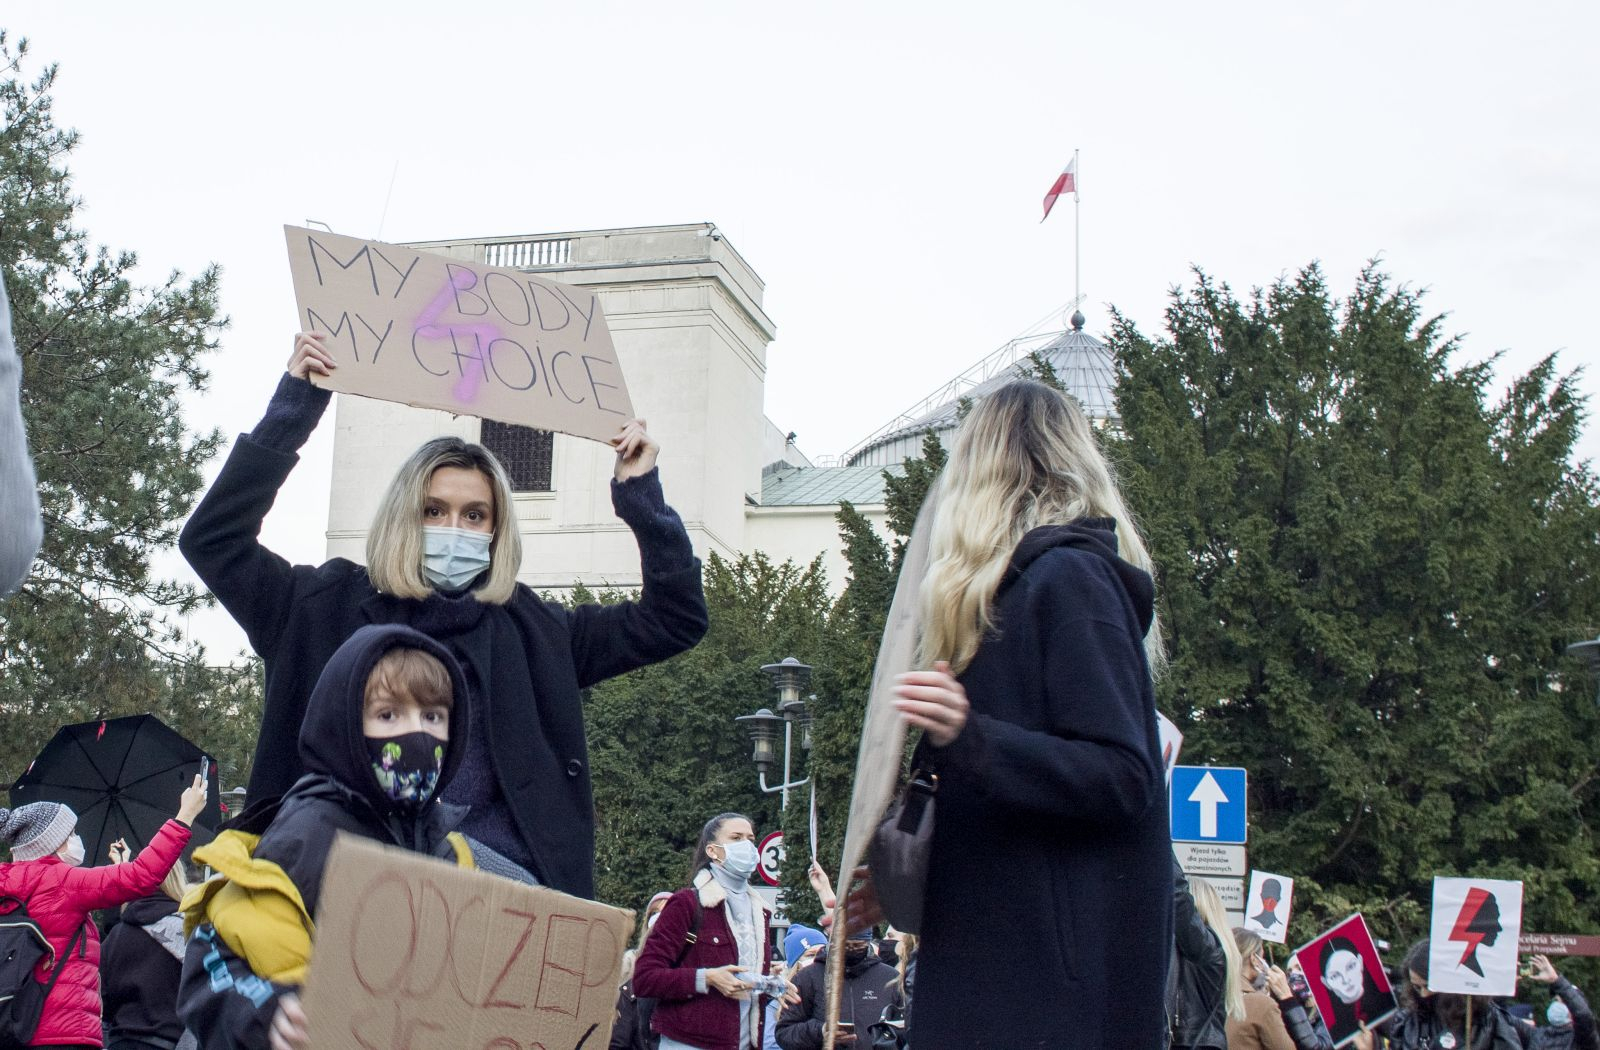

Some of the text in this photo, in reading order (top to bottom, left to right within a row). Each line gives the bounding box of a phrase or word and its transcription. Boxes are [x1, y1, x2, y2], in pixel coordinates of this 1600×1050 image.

[307, 235, 595, 342] MY BODY
[306, 307, 394, 365] MY
[1211, 847, 1227, 855] tylko
[1550, 934, 1576, 947] Sejmu
